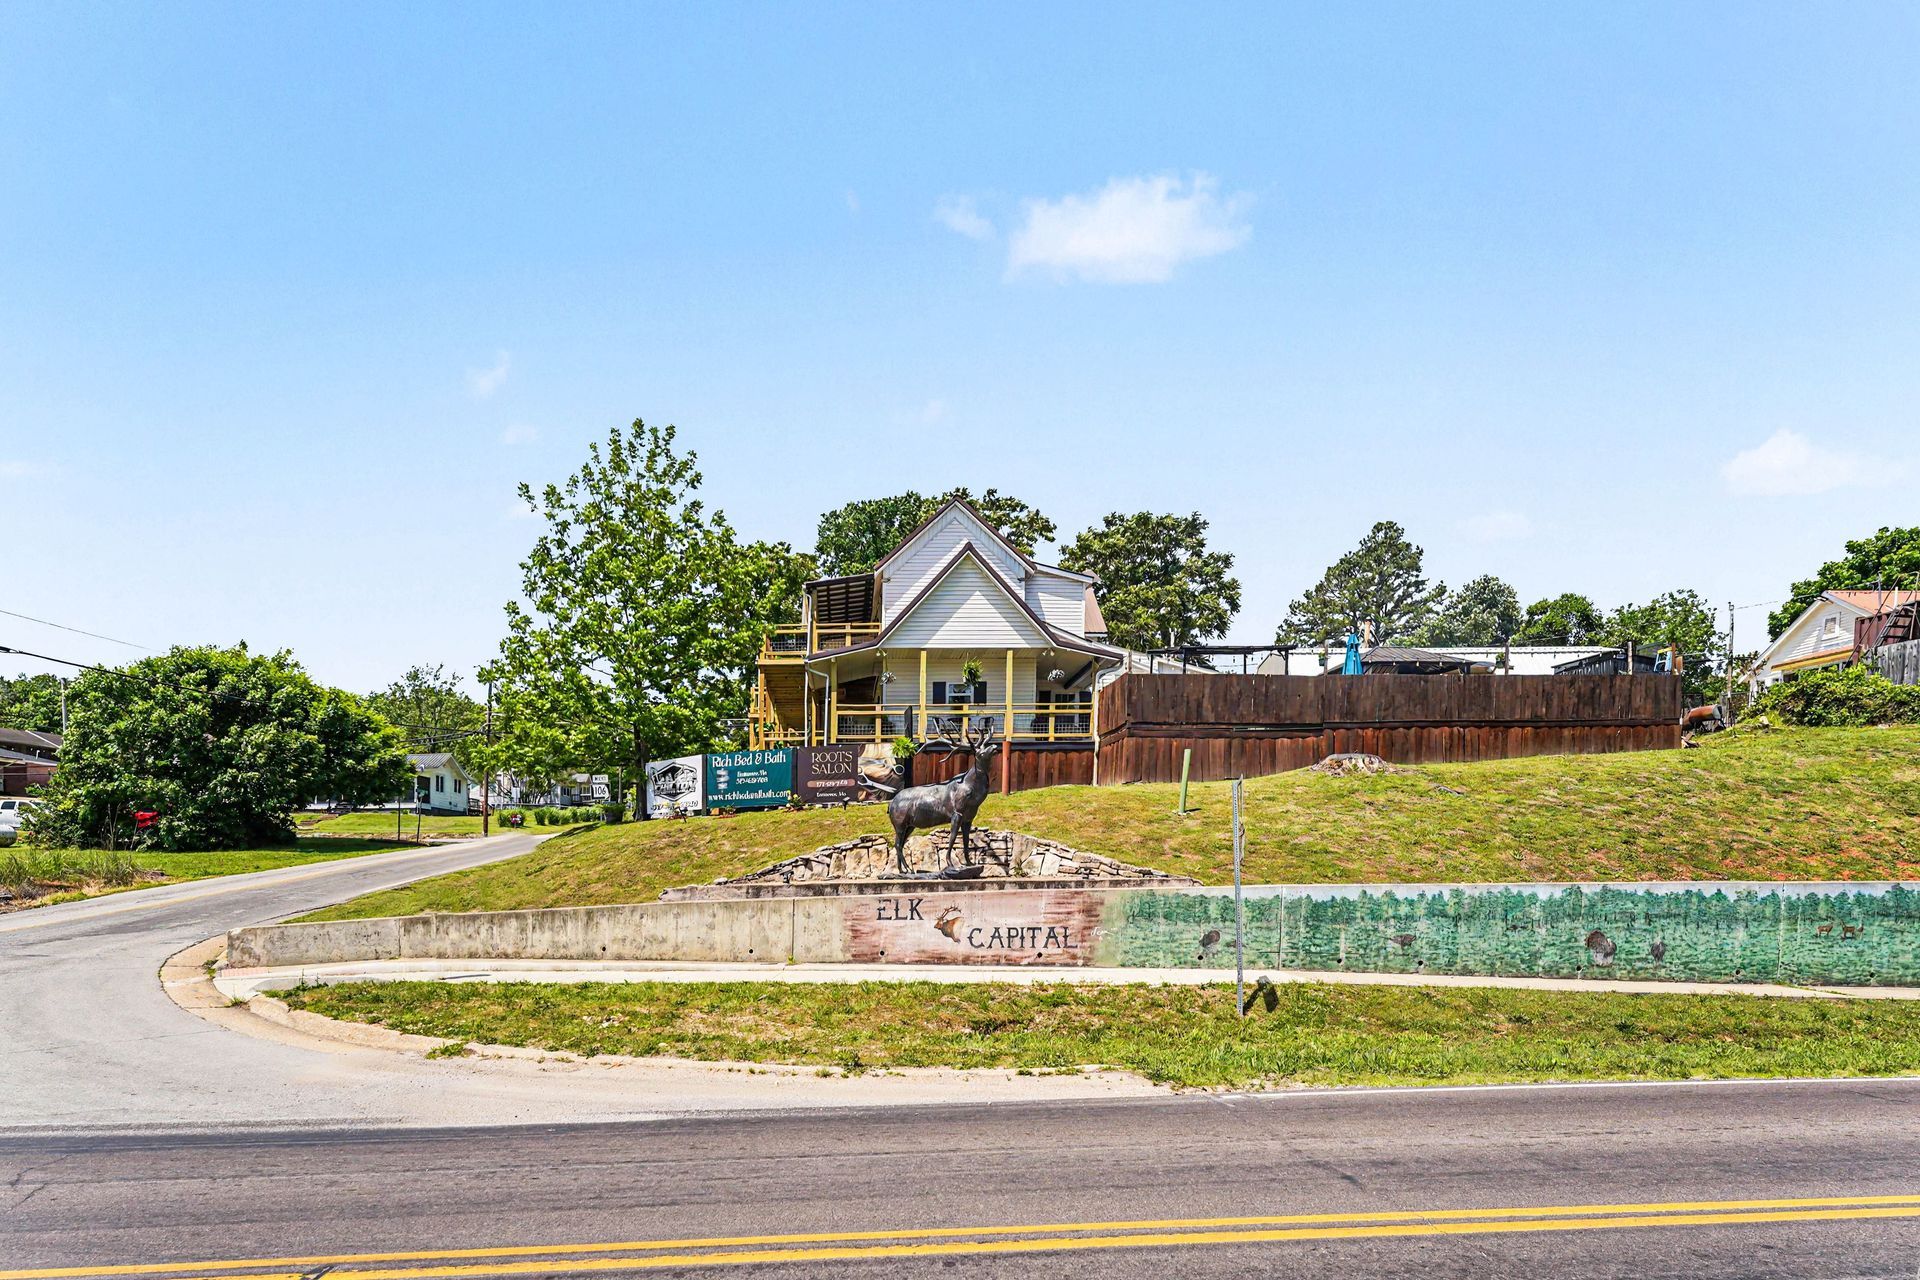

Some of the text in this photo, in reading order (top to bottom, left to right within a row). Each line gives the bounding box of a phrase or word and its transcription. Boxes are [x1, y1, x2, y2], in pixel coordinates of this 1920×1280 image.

[712, 750, 786, 768] Rich Bed & Bath
[811, 751, 853, 763] ROOTS
[811, 762, 852, 775] SALON
[595, 786, 606, 795] 106
[876, 898, 924, 921] ELK
[967, 926, 1078, 949] CAPITAL
